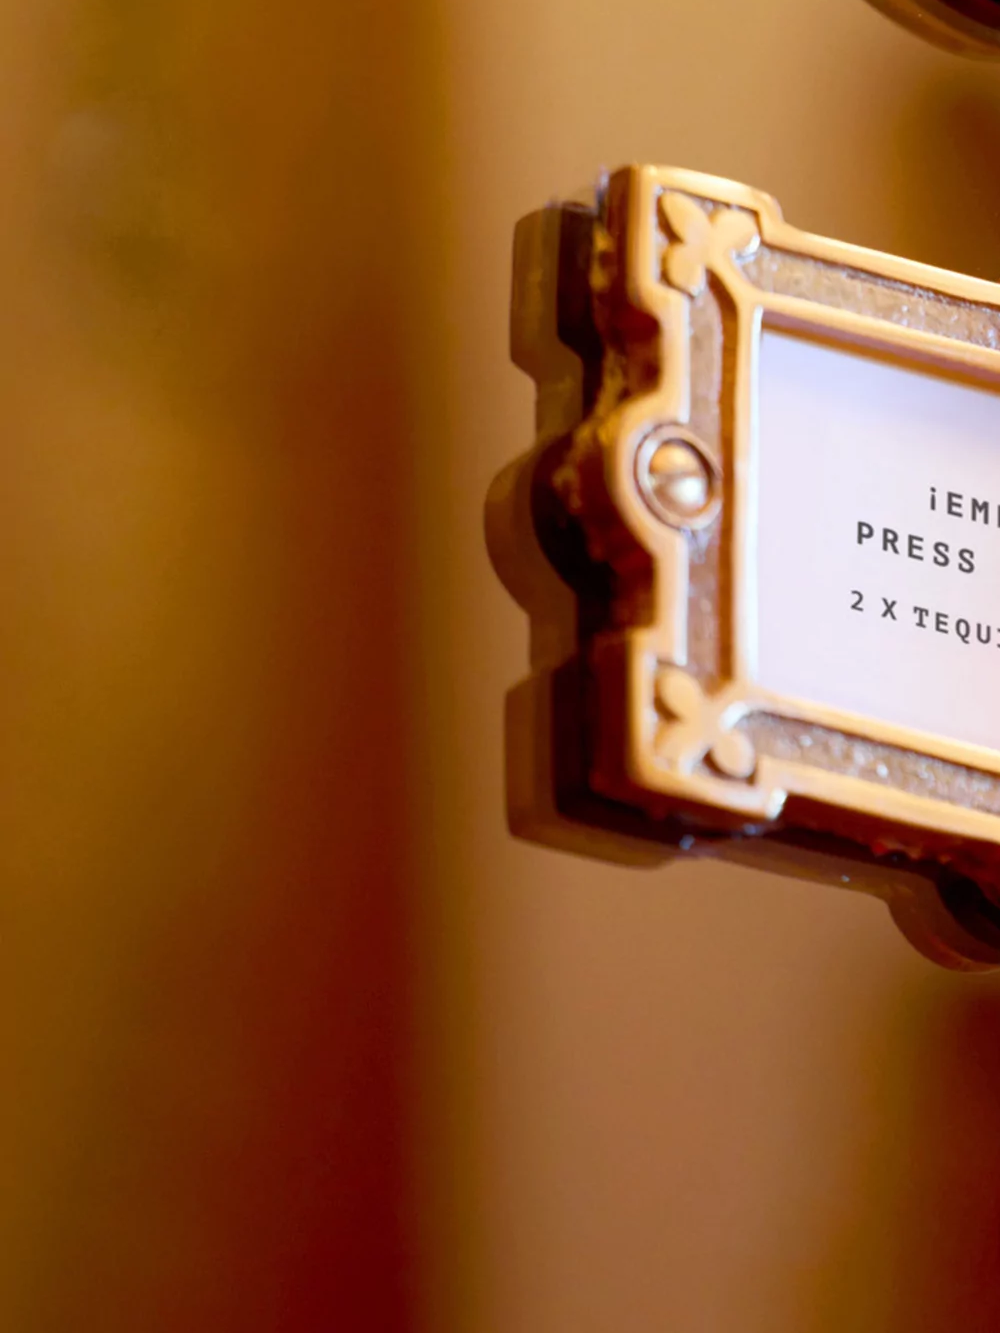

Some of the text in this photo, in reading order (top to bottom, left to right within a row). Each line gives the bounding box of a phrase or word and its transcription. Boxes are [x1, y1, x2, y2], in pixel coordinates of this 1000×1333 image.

[857, 521, 975, 574] PRESS
[850, 590, 864, 612] 2
[881, 597, 897, 621] X
